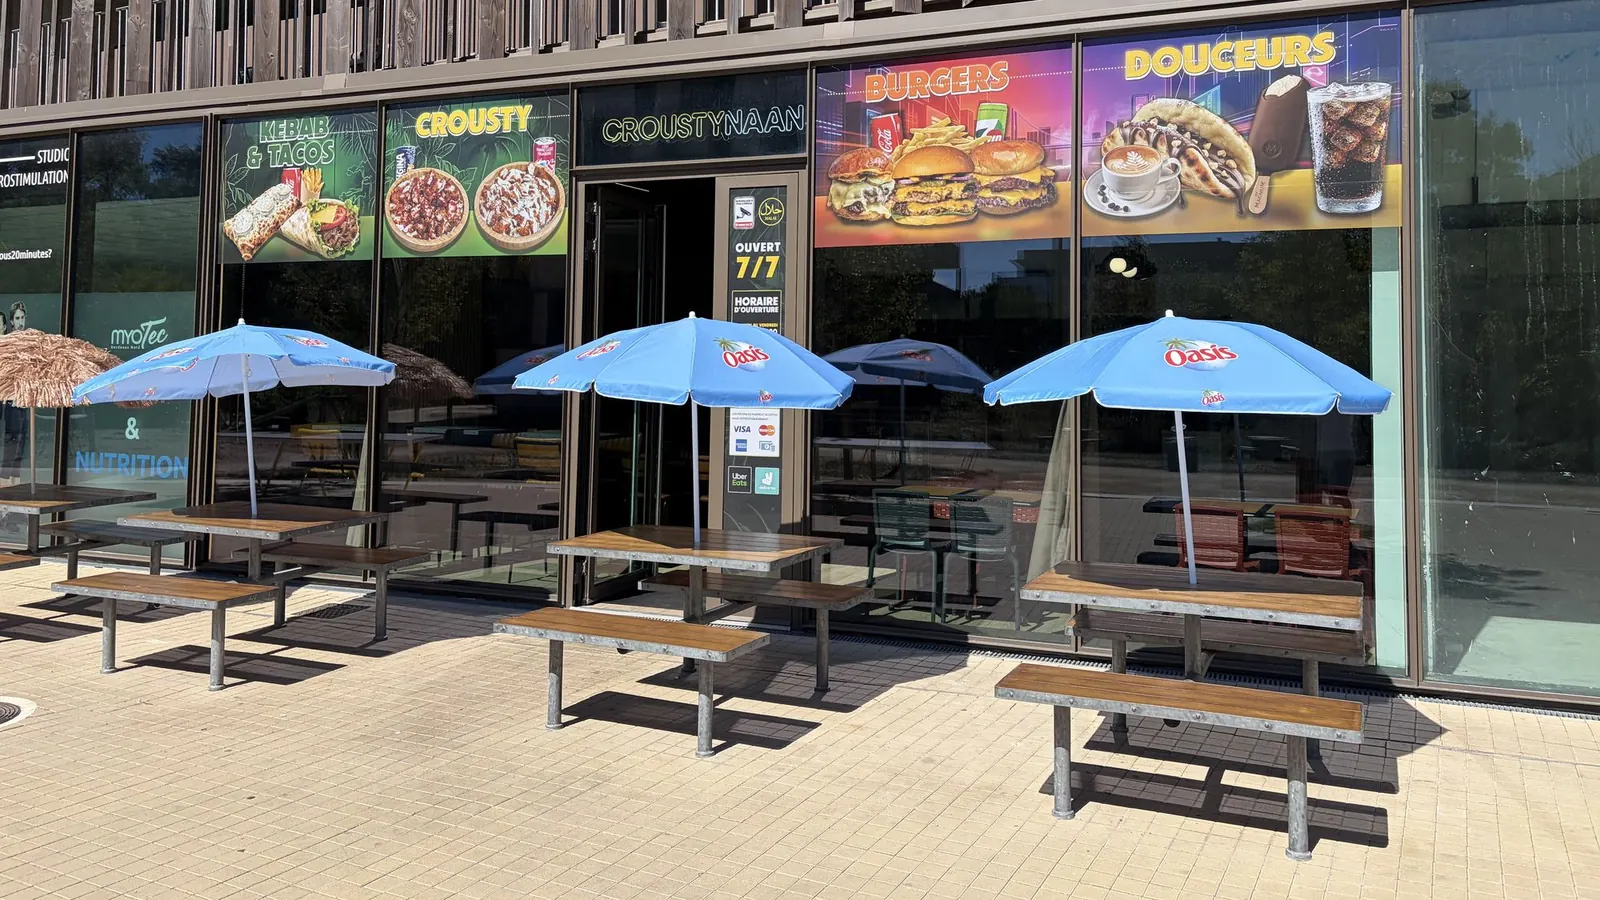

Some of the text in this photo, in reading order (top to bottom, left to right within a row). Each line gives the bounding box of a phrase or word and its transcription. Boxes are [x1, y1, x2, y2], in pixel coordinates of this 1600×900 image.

[1125, 31, 1336, 81] DOUCEURS
[865, 60, 1009, 103] BURGERS
[259, 115, 330, 143] KEBAB
[415, 104, 533, 138] CROUSTY
[602, 104, 804, 144] CROUSTYNAAN
[246, 140, 335, 169] & TACOS
[735, 242, 781, 253] OUVERT
[736, 256, 780, 279] 7/7
[734, 296, 779, 306] HORAIRE
[722, 345, 769, 368] Oasis
[1163, 344, 1238, 367] Oasis
[1202, 393, 1225, 406] Oasis
[125, 417, 140, 440] &
[75, 450, 188, 479] NUTRITION
